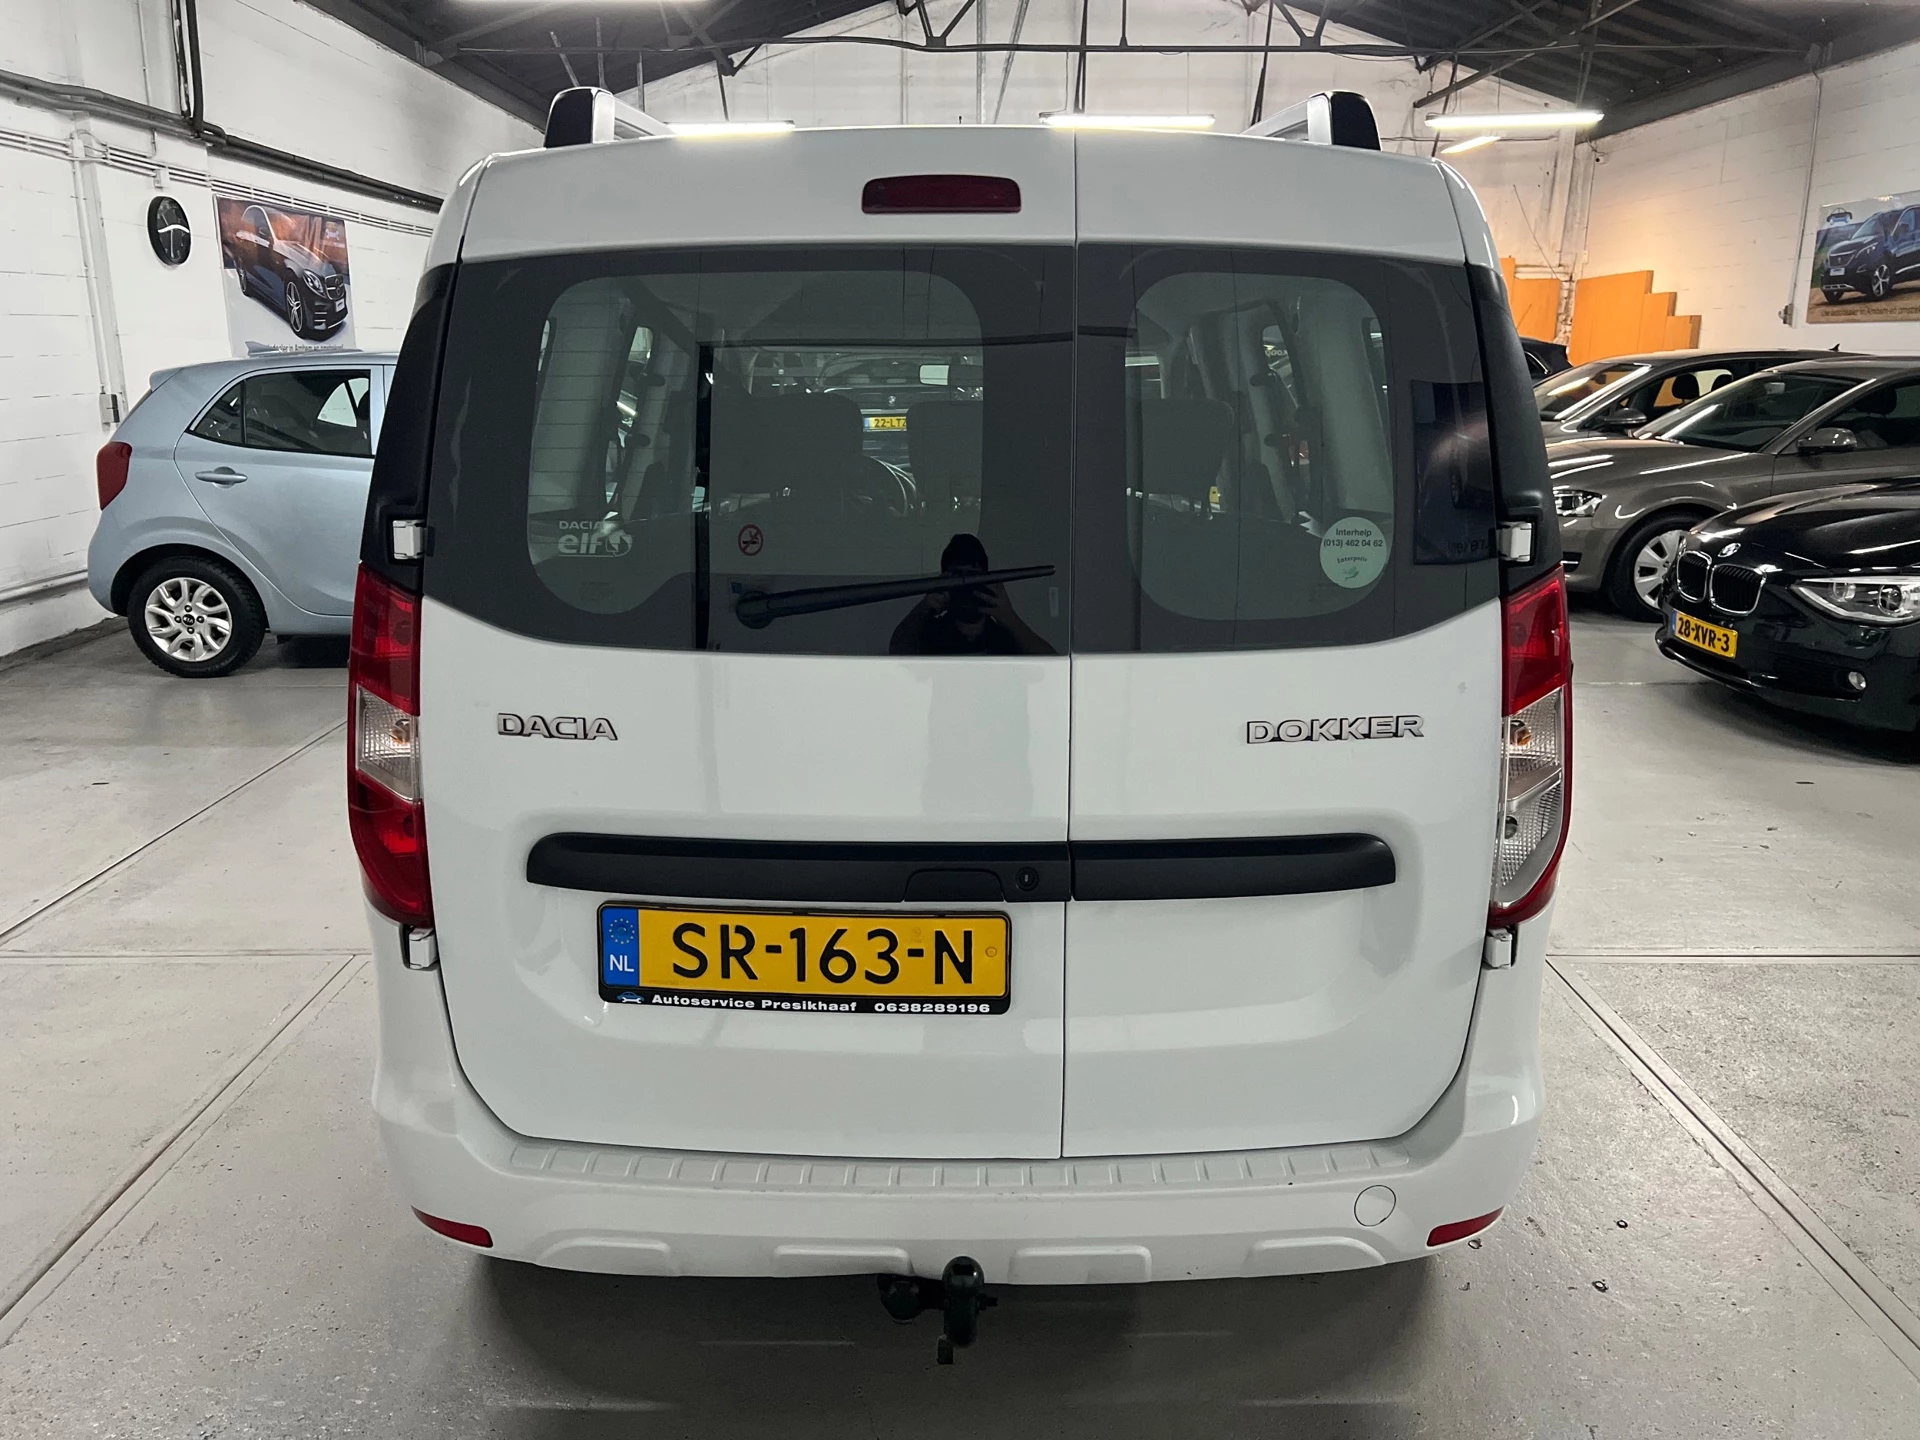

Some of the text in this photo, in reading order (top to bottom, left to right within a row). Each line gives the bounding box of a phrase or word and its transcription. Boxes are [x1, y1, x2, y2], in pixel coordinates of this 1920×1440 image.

[558, 532, 602, 554] elf
[1323, 539, 1343, 548] (013)
[1335, 528, 1372, 537] Interhelp
[1678, 617, 1730, 653] 28-XVR-3
[497, 712, 618, 741] DACIA
[1247, 715, 1425, 744] DOKKER
[609, 954, 635, 972] NL
[672, 922, 974, 985] SR-163-N
[651, 994, 991, 1013] Autoservice Presikhaaf 0638289196
